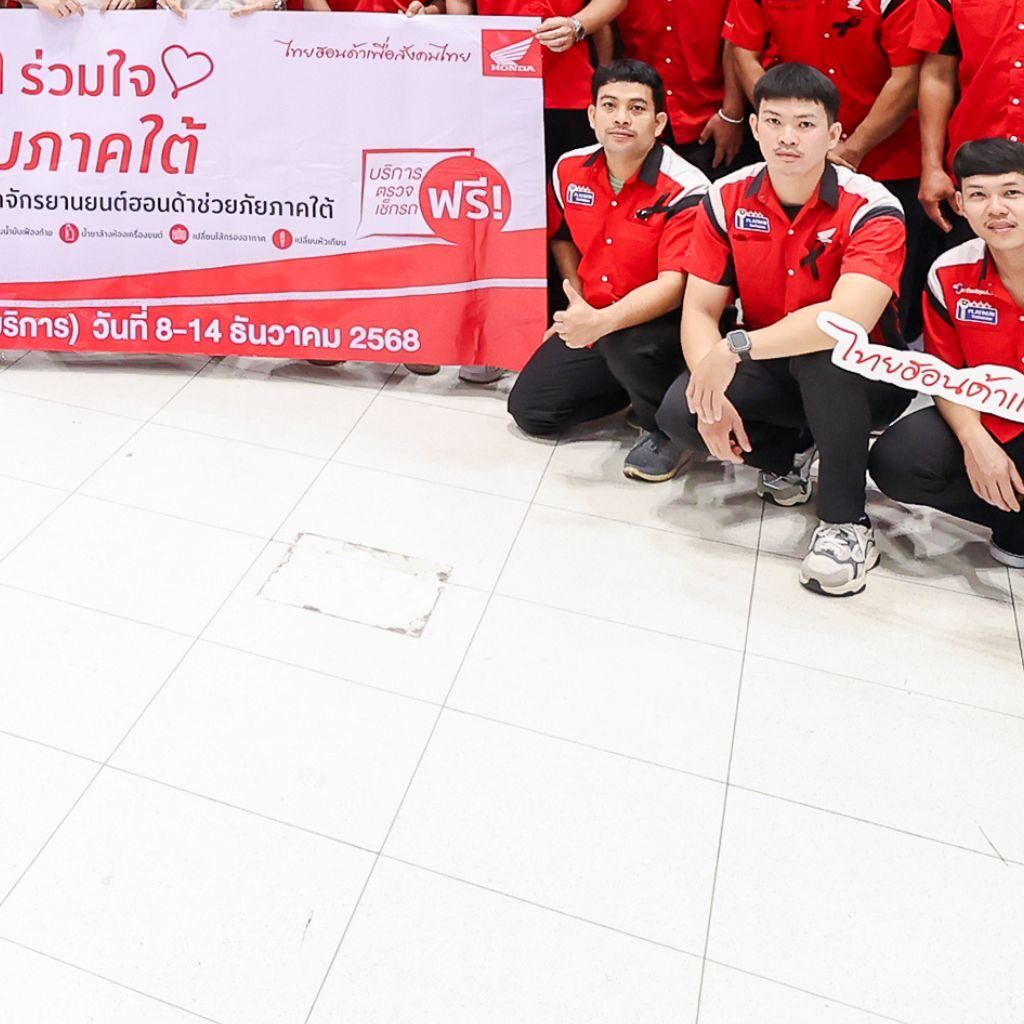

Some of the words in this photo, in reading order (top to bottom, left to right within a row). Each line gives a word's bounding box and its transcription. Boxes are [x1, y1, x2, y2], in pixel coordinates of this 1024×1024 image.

[21, 49, 156, 97] ร่วมใจ
[490, 64, 537, 72] HONDA
[369, 164, 423, 181] บริการ
[376, 186, 414, 198] ตรวจ
[428, 177, 503, 220] ฟรี!
[93, 305, 148, 340] วันที่
[156, 317, 222, 343] 8-14
[229, 315, 341, 349] ธันวาคม
[349, 326, 421, 352] 2568
